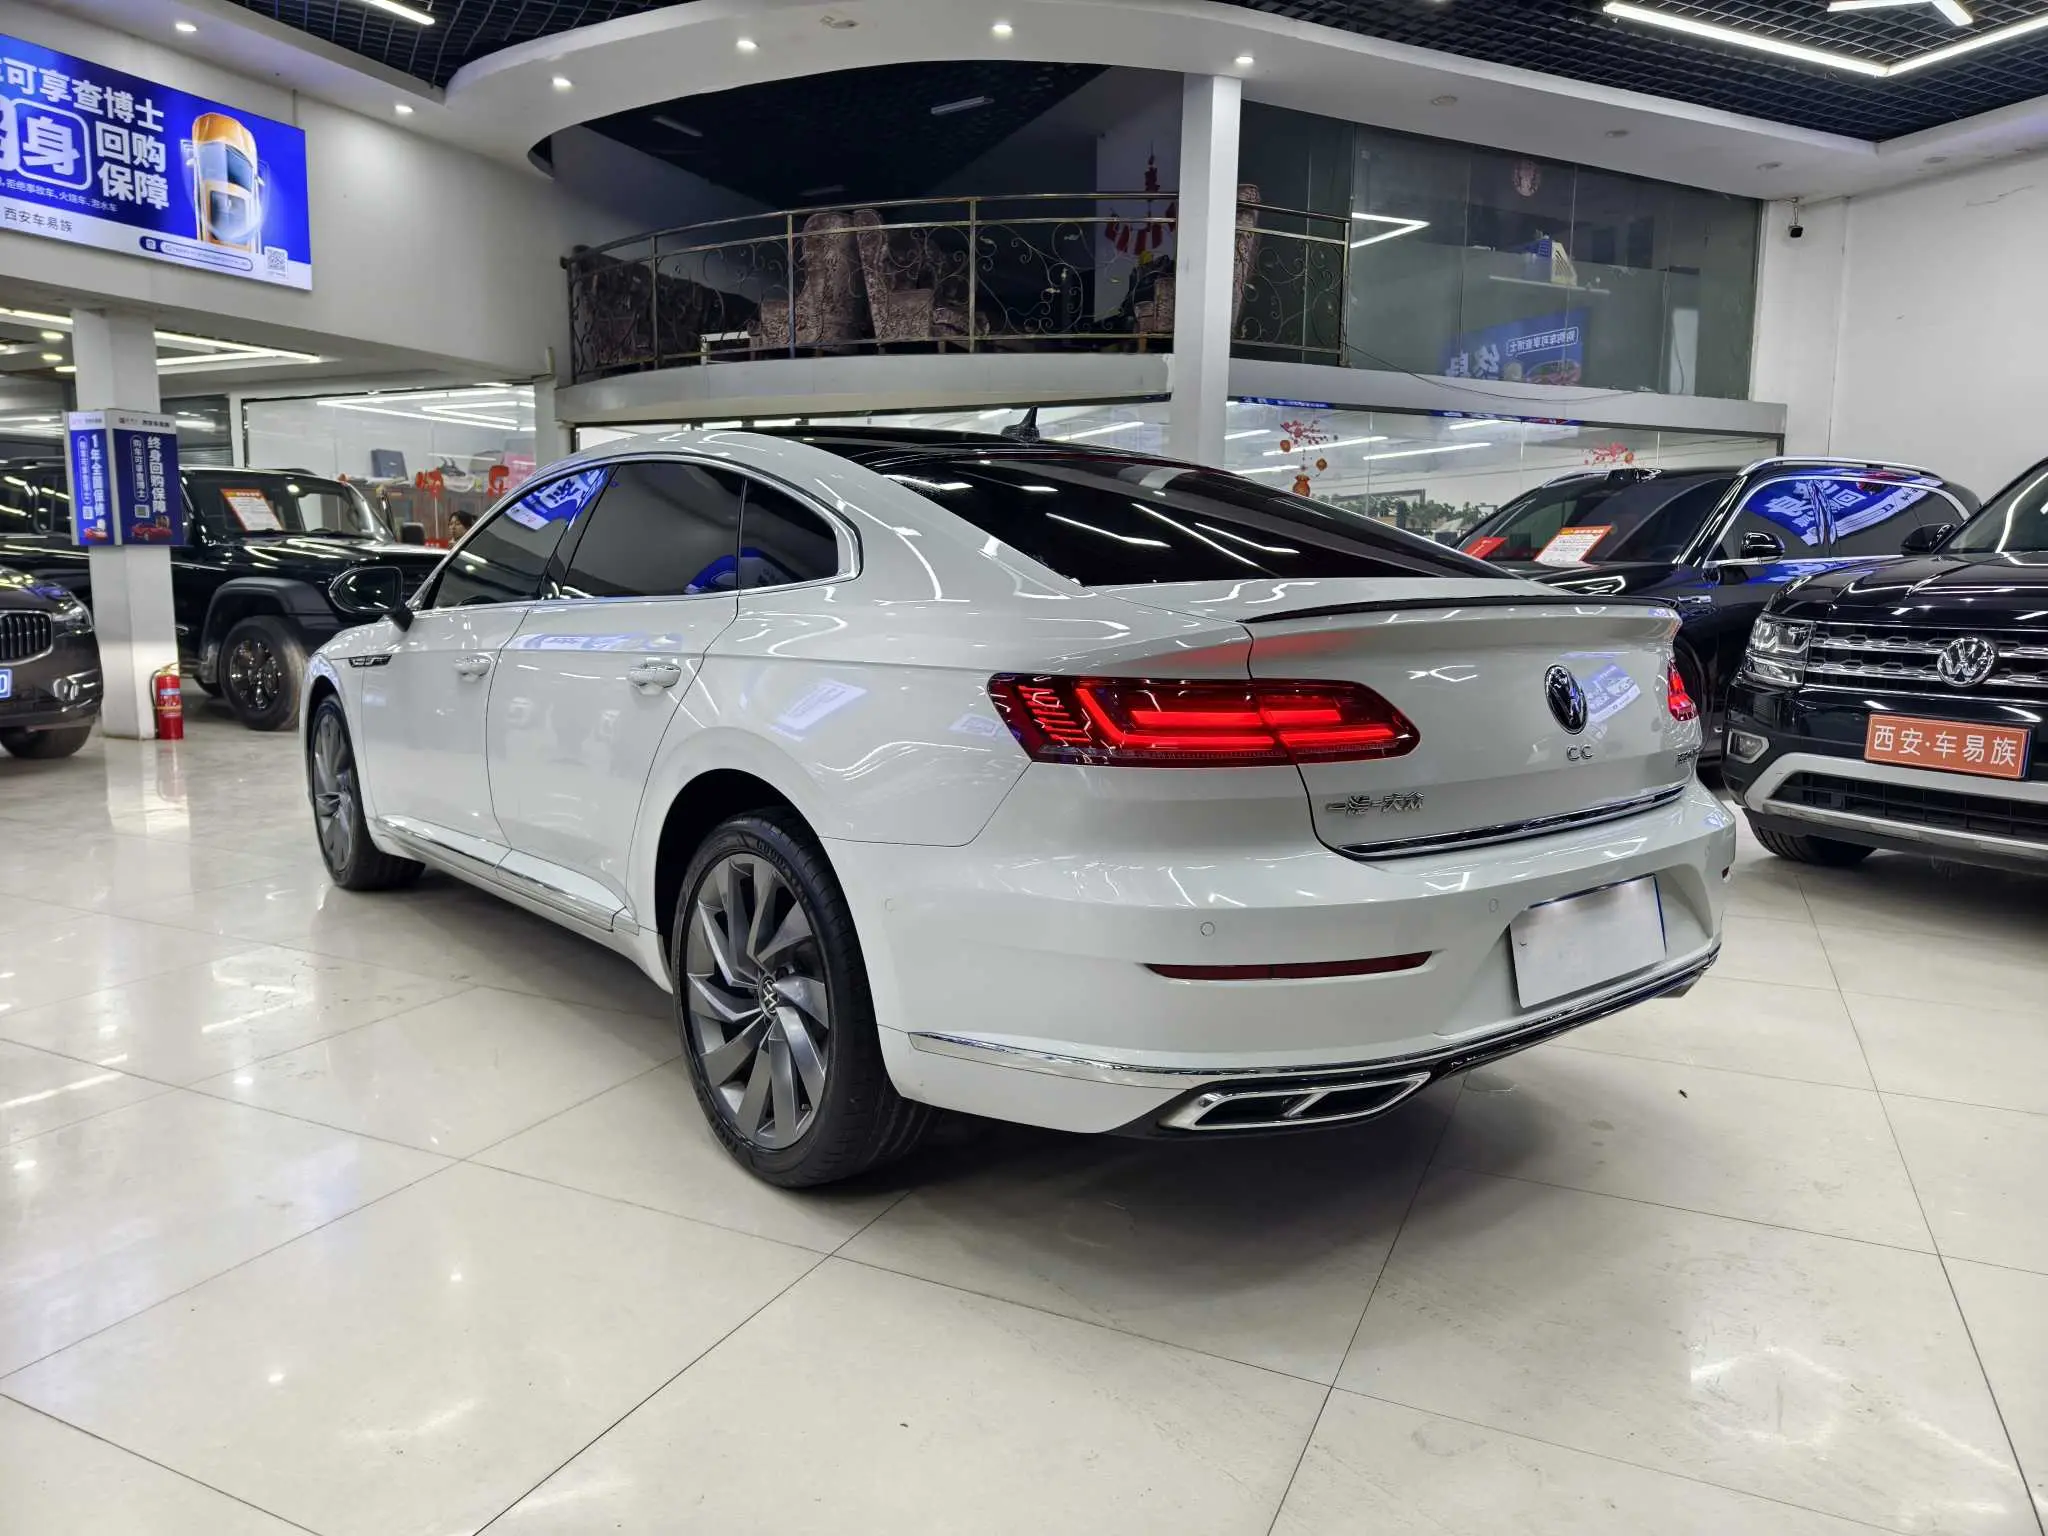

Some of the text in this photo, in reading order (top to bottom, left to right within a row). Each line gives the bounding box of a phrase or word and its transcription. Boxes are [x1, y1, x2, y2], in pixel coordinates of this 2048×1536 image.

[0, 57, 164, 133] 可享查博士
[95, 120, 166, 173] 回购
[97, 161, 169, 210] 保障
[4, 207, 73, 233] 西安车易族
[147, 435, 168, 514] 终身回购保障
[1566, 744, 1593, 761] CC
[1873, 724, 2018, 768] 西安·车易族
